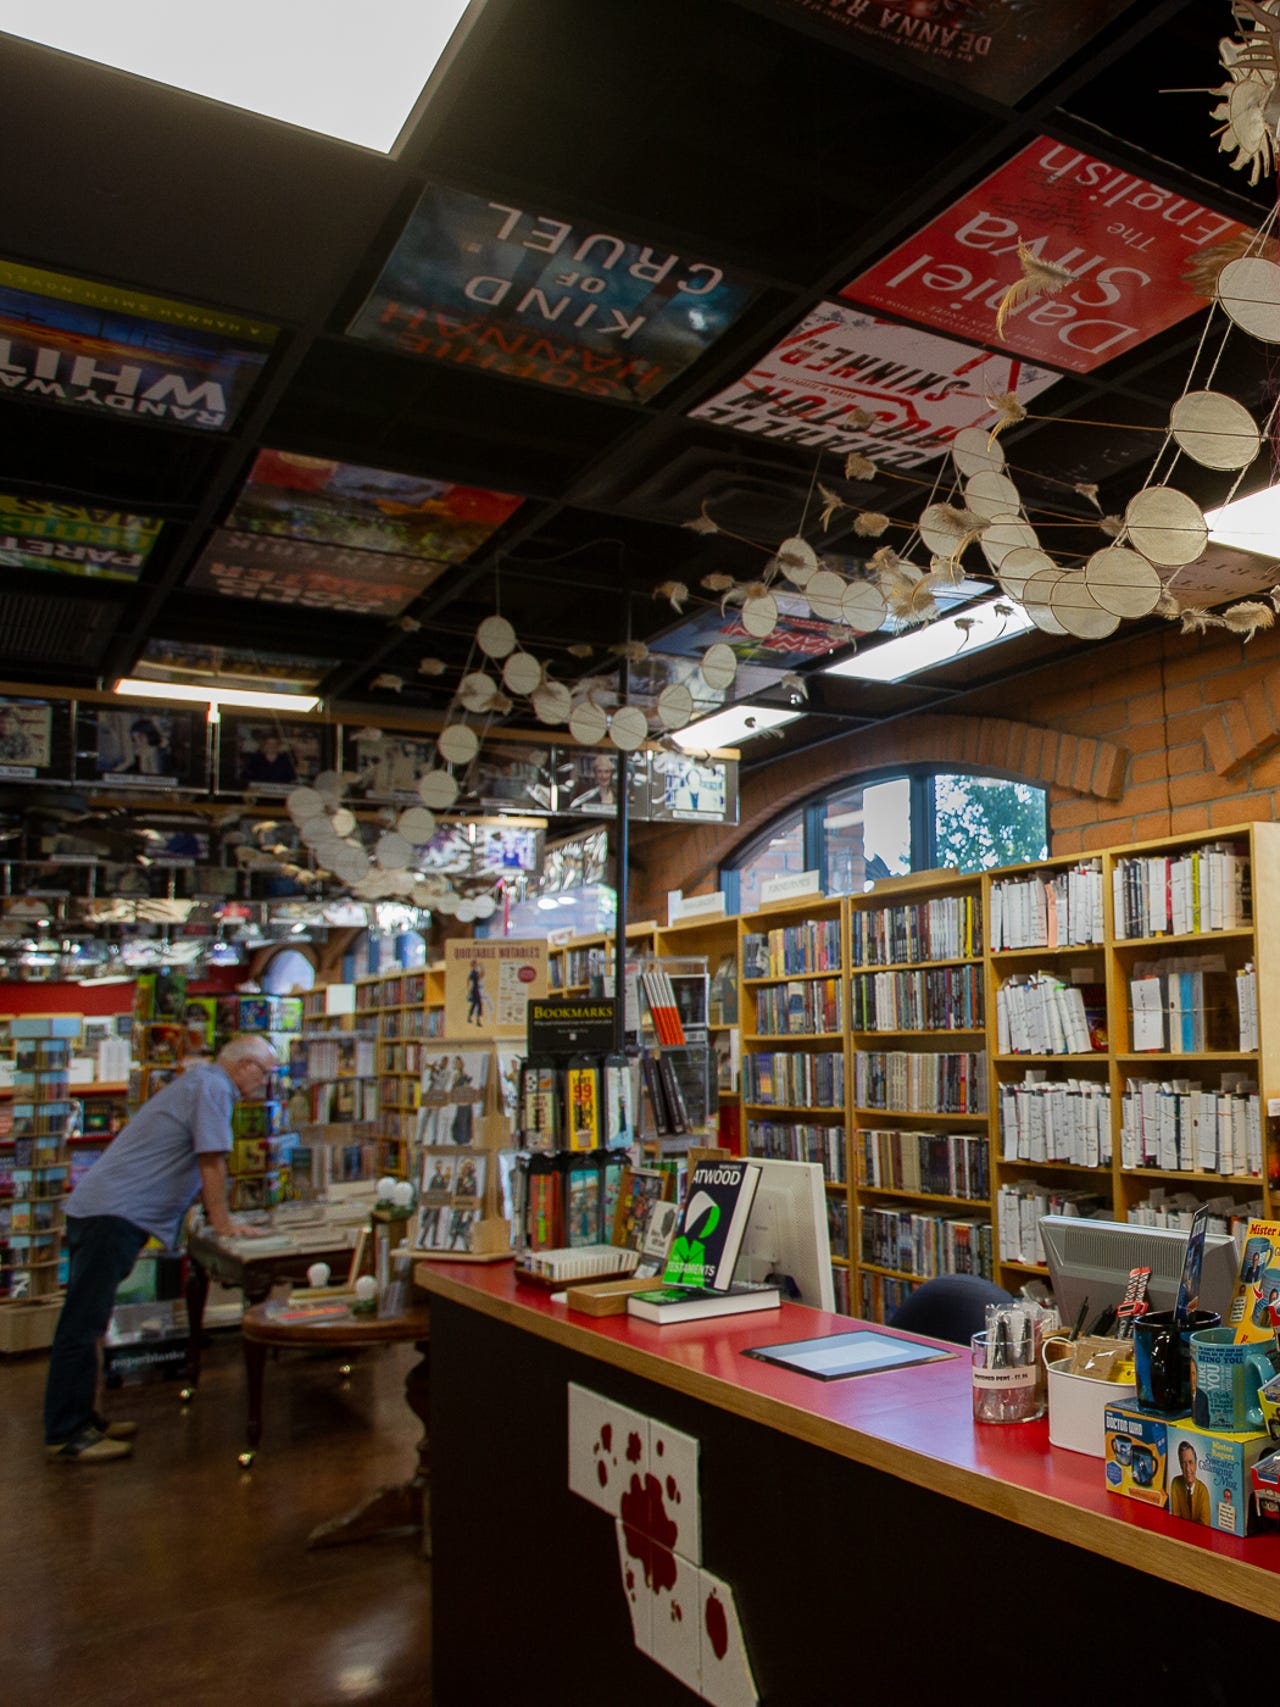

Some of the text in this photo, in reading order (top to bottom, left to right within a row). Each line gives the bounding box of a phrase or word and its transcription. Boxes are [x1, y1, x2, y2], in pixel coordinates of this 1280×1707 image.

[878, 7, 992, 56] DEANNA
[1036, 144, 1234, 246] English
[487, 202, 725, 295] CRUEL
[1105, 221, 1156, 252] The
[555, 271, 607, 294] OF
[85, 290, 148, 312] SMITH
[463, 274, 647, 340] KIND
[885, 254, 1139, 355] Daniel
[159, 308, 241, 332] HANNAH
[378, 302, 661, 385] HANNAH
[395, 331, 619, 396] SOPHIE
[778, 340, 970, 402] SKINNER
[74, 389, 226, 426] RANDY
[533, 1005, 613, 1020] BOOKMARKS
[692, 1168, 741, 1186] ATWOOD
[1249, 1223, 1277, 1236] Mister
[667, 1261, 716, 1277] TESTAMENTS
[1207, 1363, 1221, 1391] YOU
[1211, 1441, 1233, 1453] Mister
[1211, 1449, 1235, 1461] Rogers
[1198, 1460, 1233, 1480] Changing
[1204, 1453, 1240, 1470] Sweater
[1214, 1476, 1238, 1490] Mug
